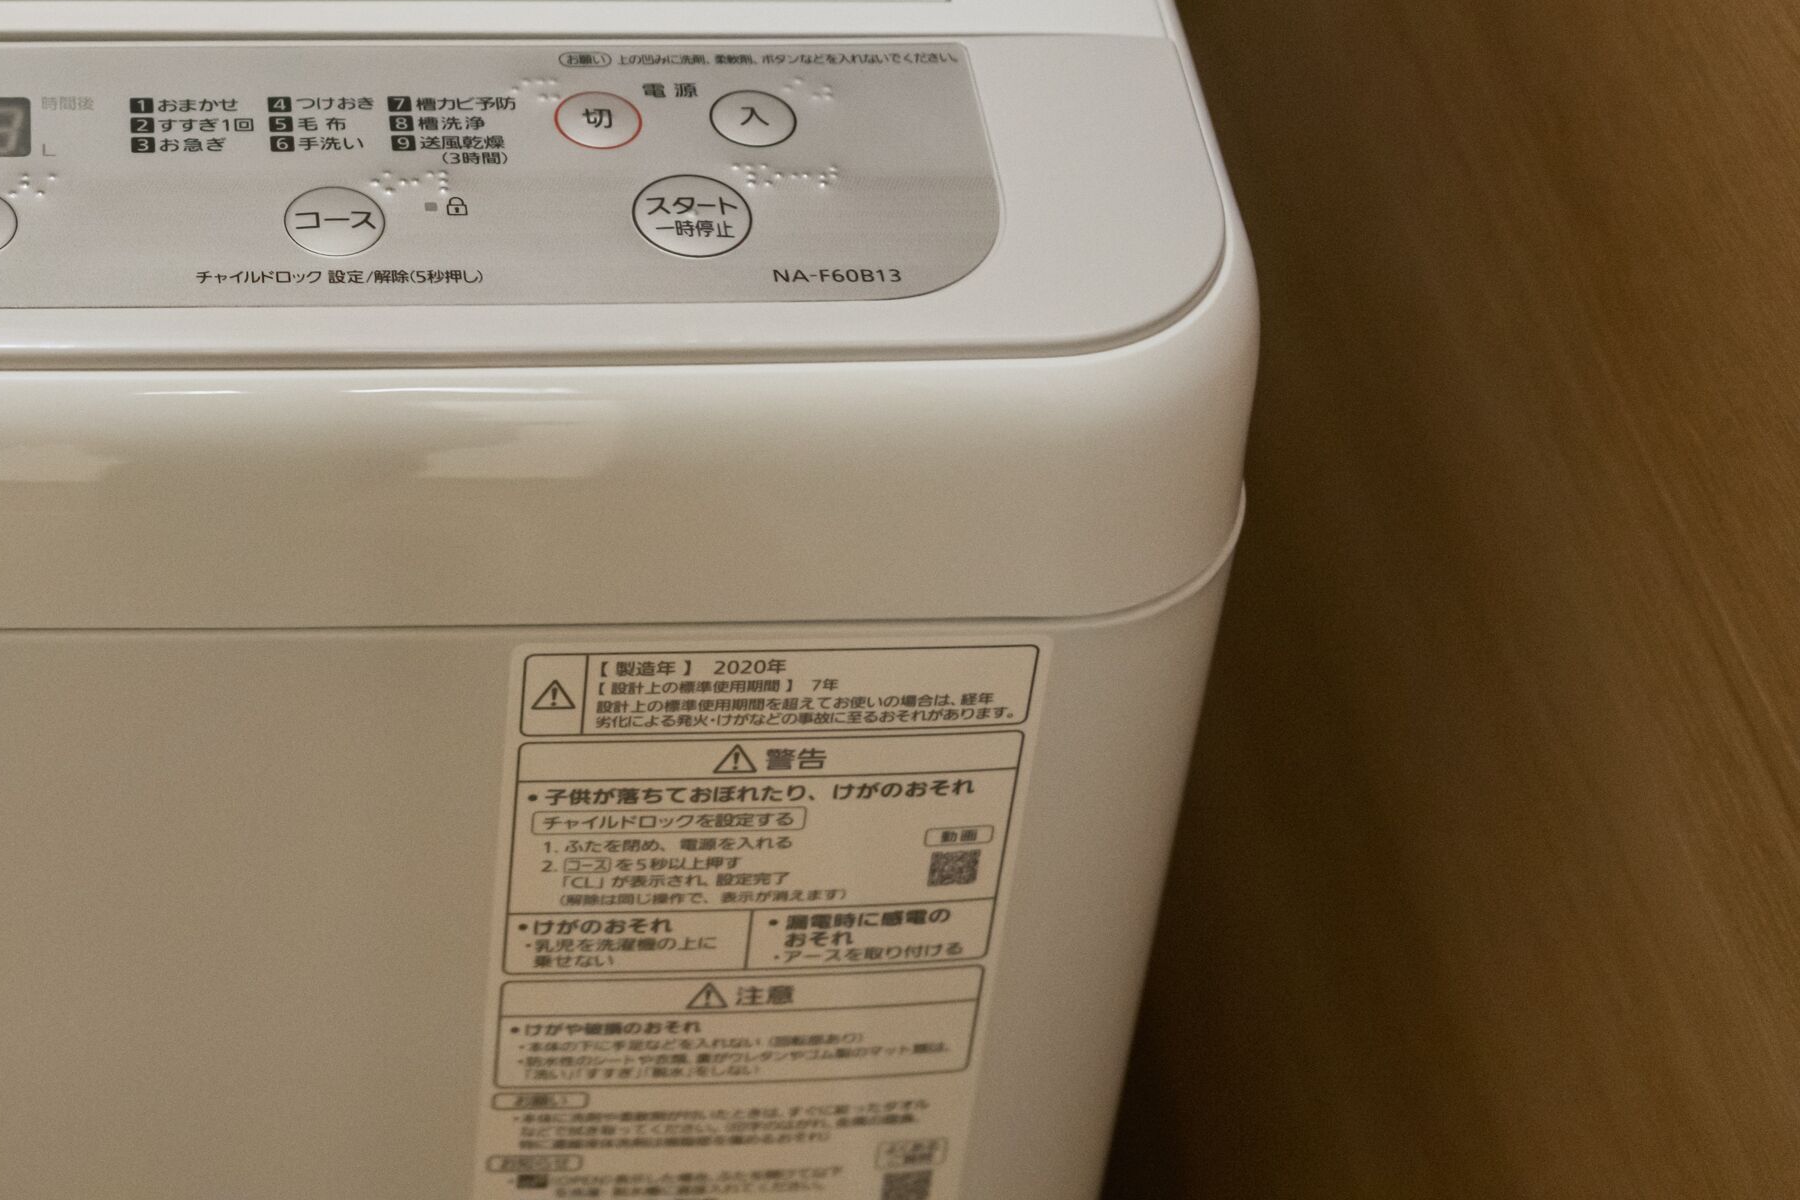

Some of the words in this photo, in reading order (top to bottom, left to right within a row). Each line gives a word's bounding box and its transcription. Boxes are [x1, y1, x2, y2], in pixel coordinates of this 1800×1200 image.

[643, 82, 698, 98] 電源
[41, 96, 94, 111] 時間後
[157, 98, 238, 113] おまかせ
[297, 97, 375, 111] つけおき
[416, 96, 517, 112] 槽カビ予防
[297, 117, 346, 132] 毛布
[418, 116, 486, 131] 槽洗浄
[582, 108, 613, 129] 切
[740, 107, 770, 126] 入
[158, 117, 255, 133] すすぎ1回
[42, 143, 57, 157] L
[159, 137, 227, 152] お急ぎ
[298, 136, 364, 151] 手洗い
[419, 135, 506, 150] 送風乾燥
[645, 196, 738, 216] スタート
[294, 211, 377, 231] コース
[655, 220, 736, 239] 一時停止
[195, 270, 322, 284] チャイルドロック
[773, 268, 902, 284] NA-F60B13
[713, 658, 788, 675] 2020年
[812, 678, 839, 692] 7年
[765, 747, 827, 771] 警告
[542, 811, 794, 831] チャイルドロックを設定する
[940, 829, 978, 844] 動画
[533, 918, 673, 936] けがのおそれ
[785, 908, 952, 931] 漏電時に感電の
[784, 930, 854, 948] おそれ
[533, 955, 614, 969] 乗せない
[735, 984, 795, 1007] 注意
